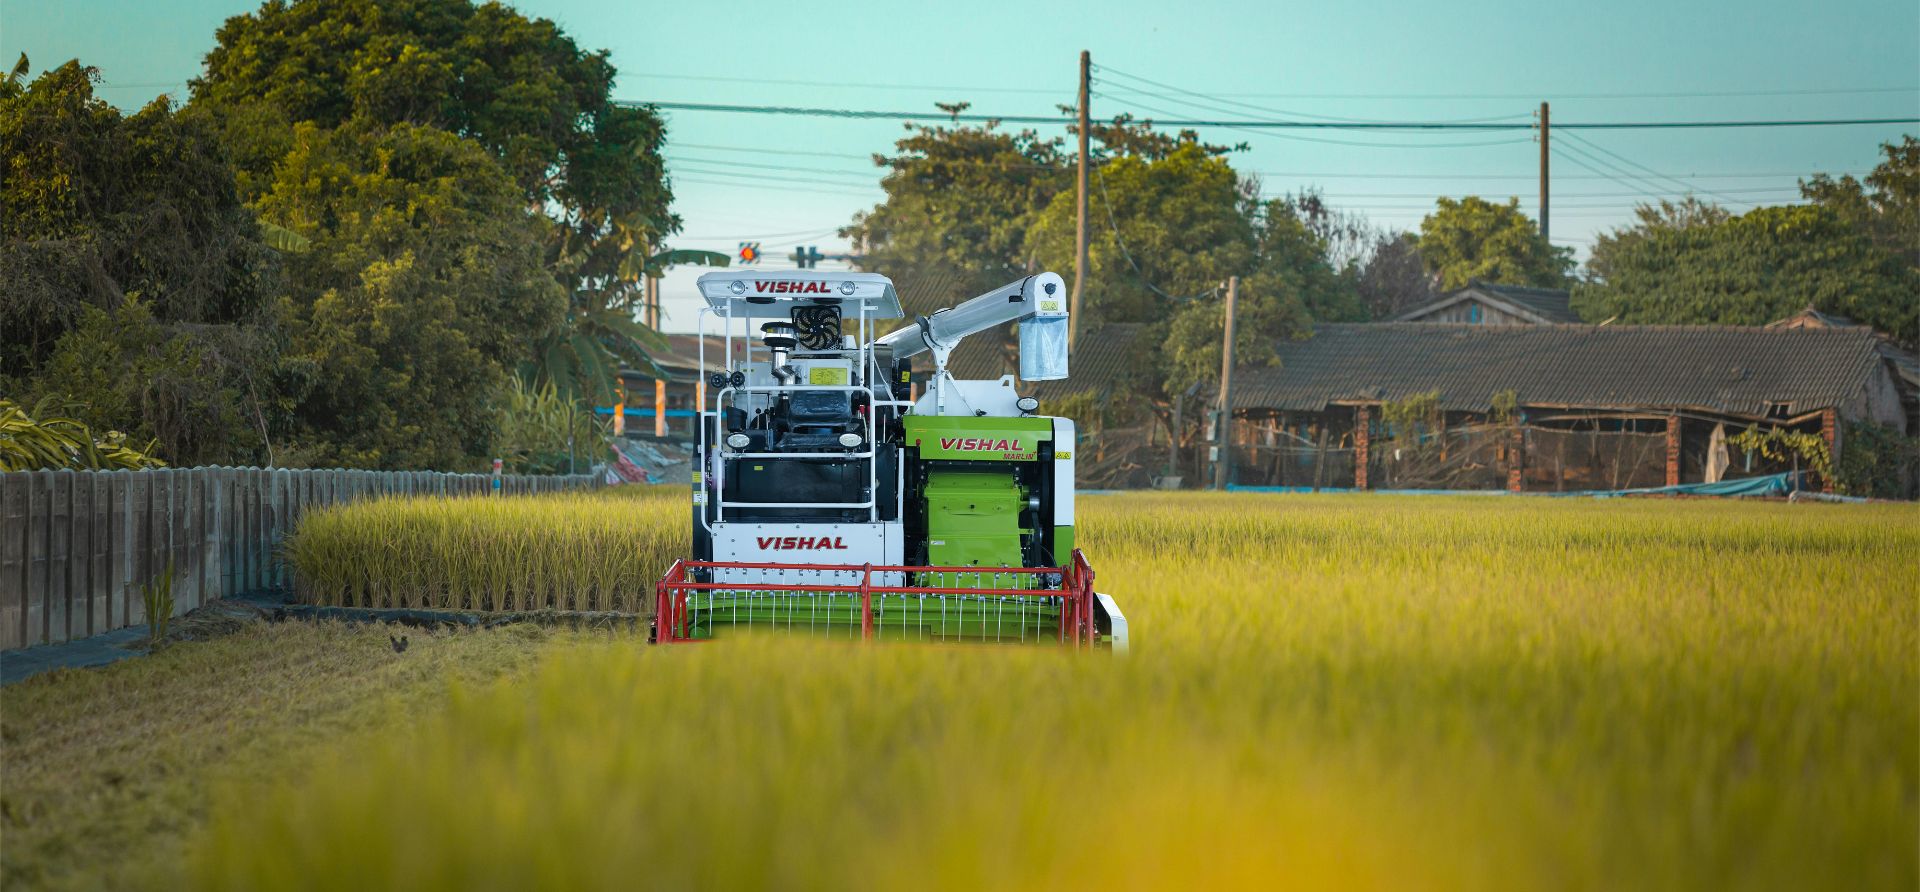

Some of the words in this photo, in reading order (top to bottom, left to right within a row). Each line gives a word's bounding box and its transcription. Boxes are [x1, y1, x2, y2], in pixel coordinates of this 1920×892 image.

[755, 280, 832, 294] VISHAL
[940, 438, 1024, 451] VISHAL
[756, 536, 848, 550] VISHAL
